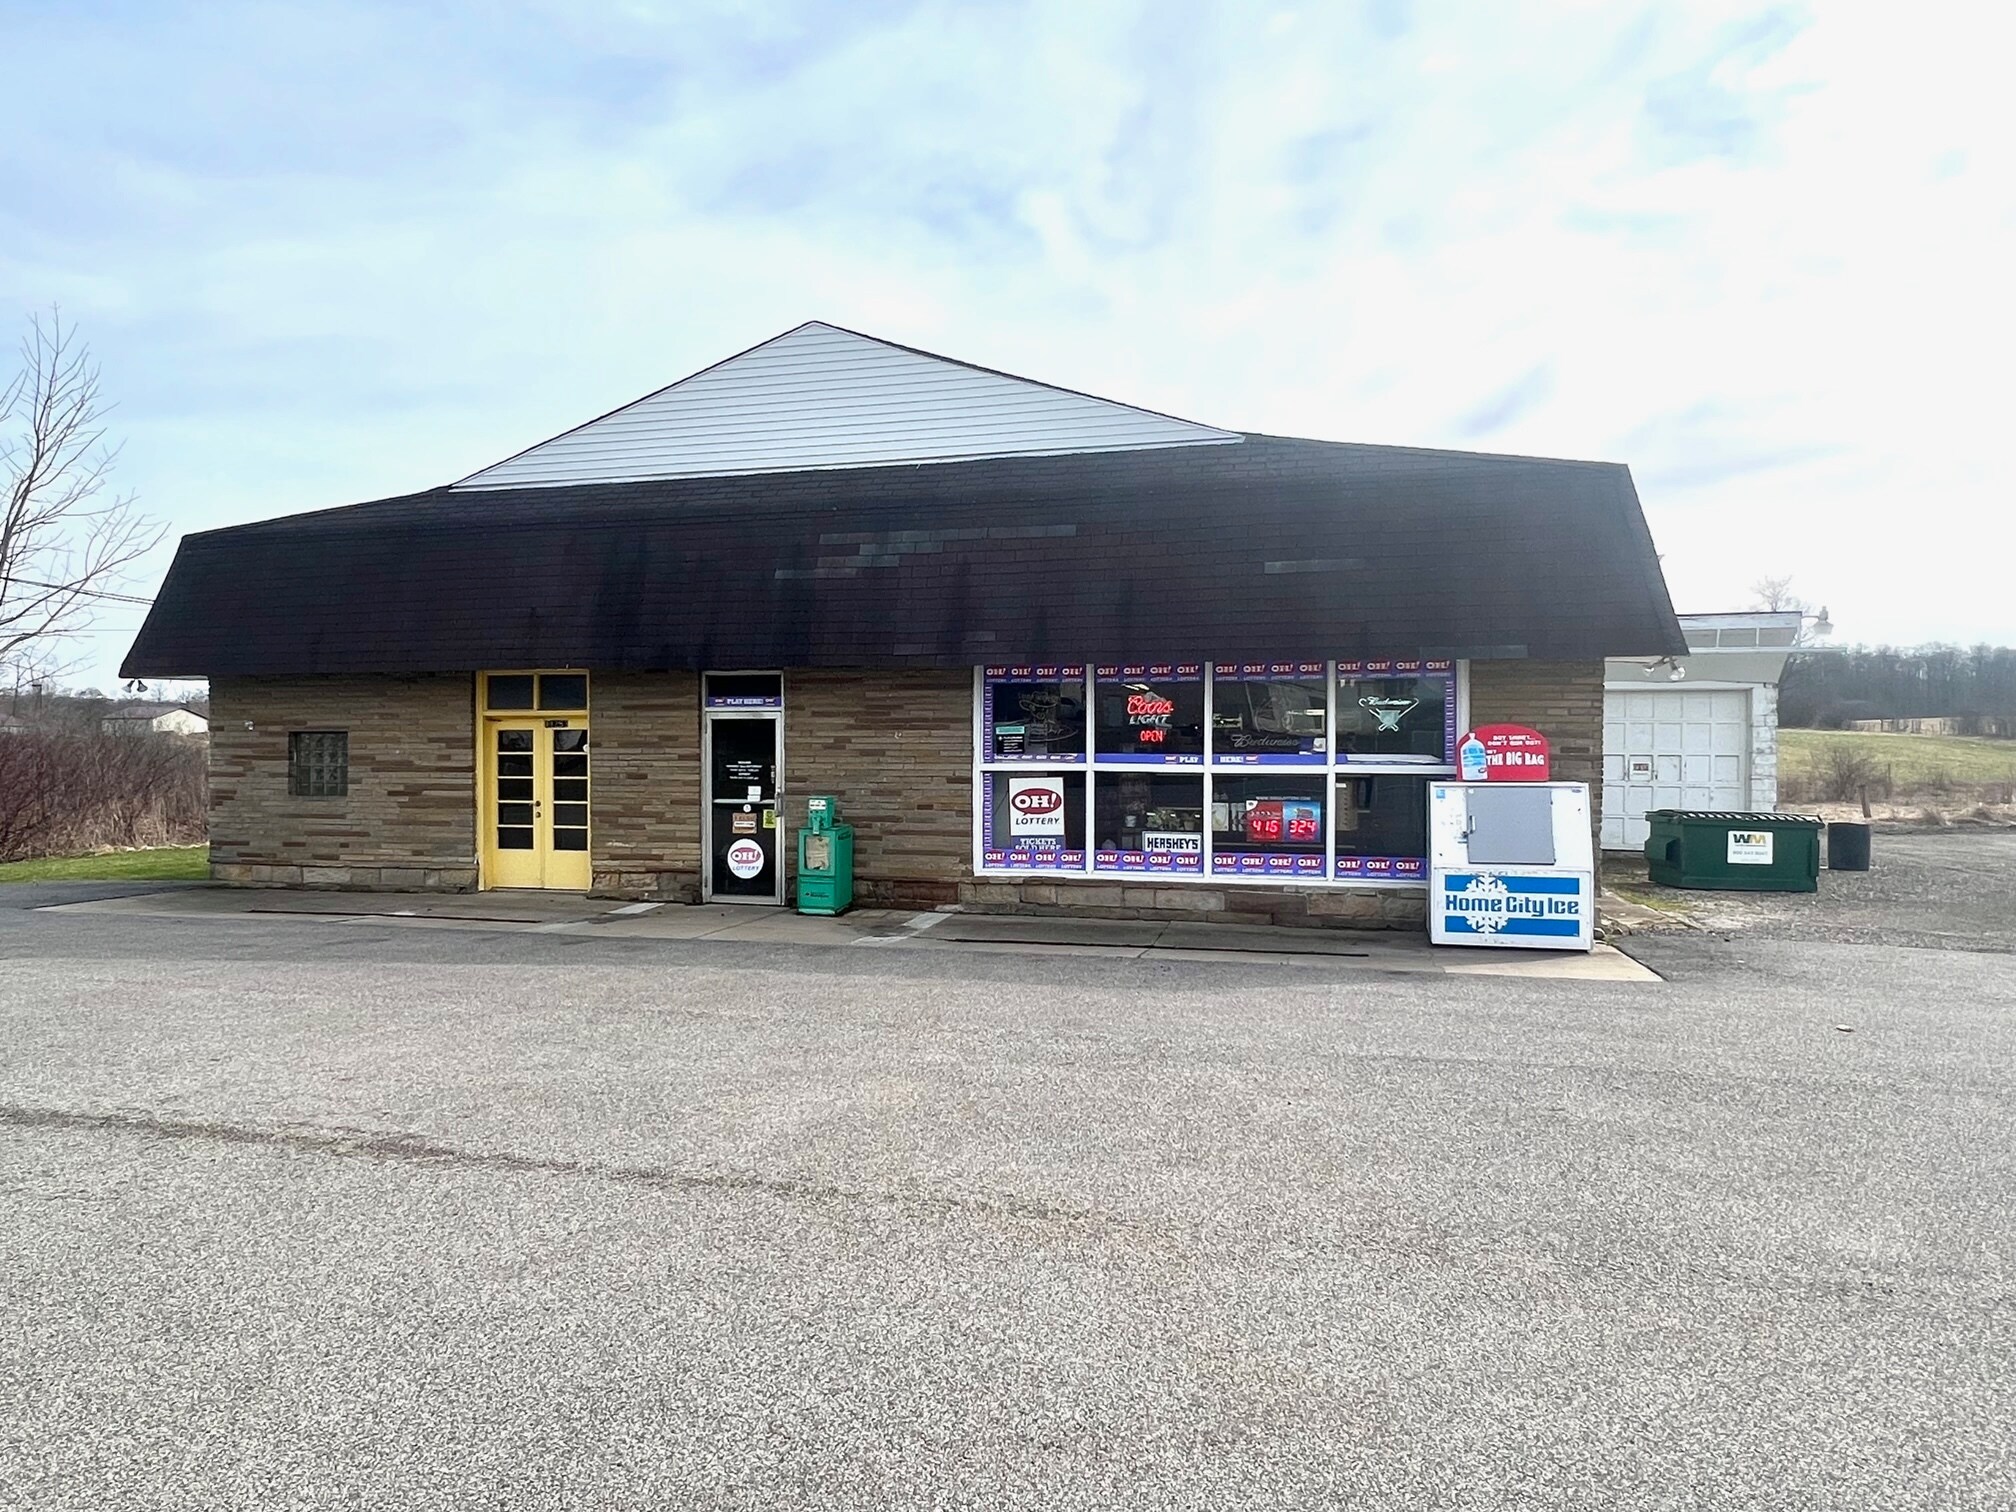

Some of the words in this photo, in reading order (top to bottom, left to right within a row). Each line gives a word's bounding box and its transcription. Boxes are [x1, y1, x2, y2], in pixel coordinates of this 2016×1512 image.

[1128, 696, 1172, 714] Coors
[1141, 730, 1163, 742] OPEN
[1486, 753, 1503, 765] THE
[1506, 752, 1522, 765] BIG
[1525, 753, 1545, 765] BAG
[1015, 793, 1057, 809] OH!
[1016, 817, 1060, 825] LOTTERY
[1290, 820, 1316, 833] 324
[1733, 834, 1767, 844] WM
[1446, 895, 1502, 912] Home
[1506, 896, 1544, 917] City
[1548, 897, 1580, 914] Ice
